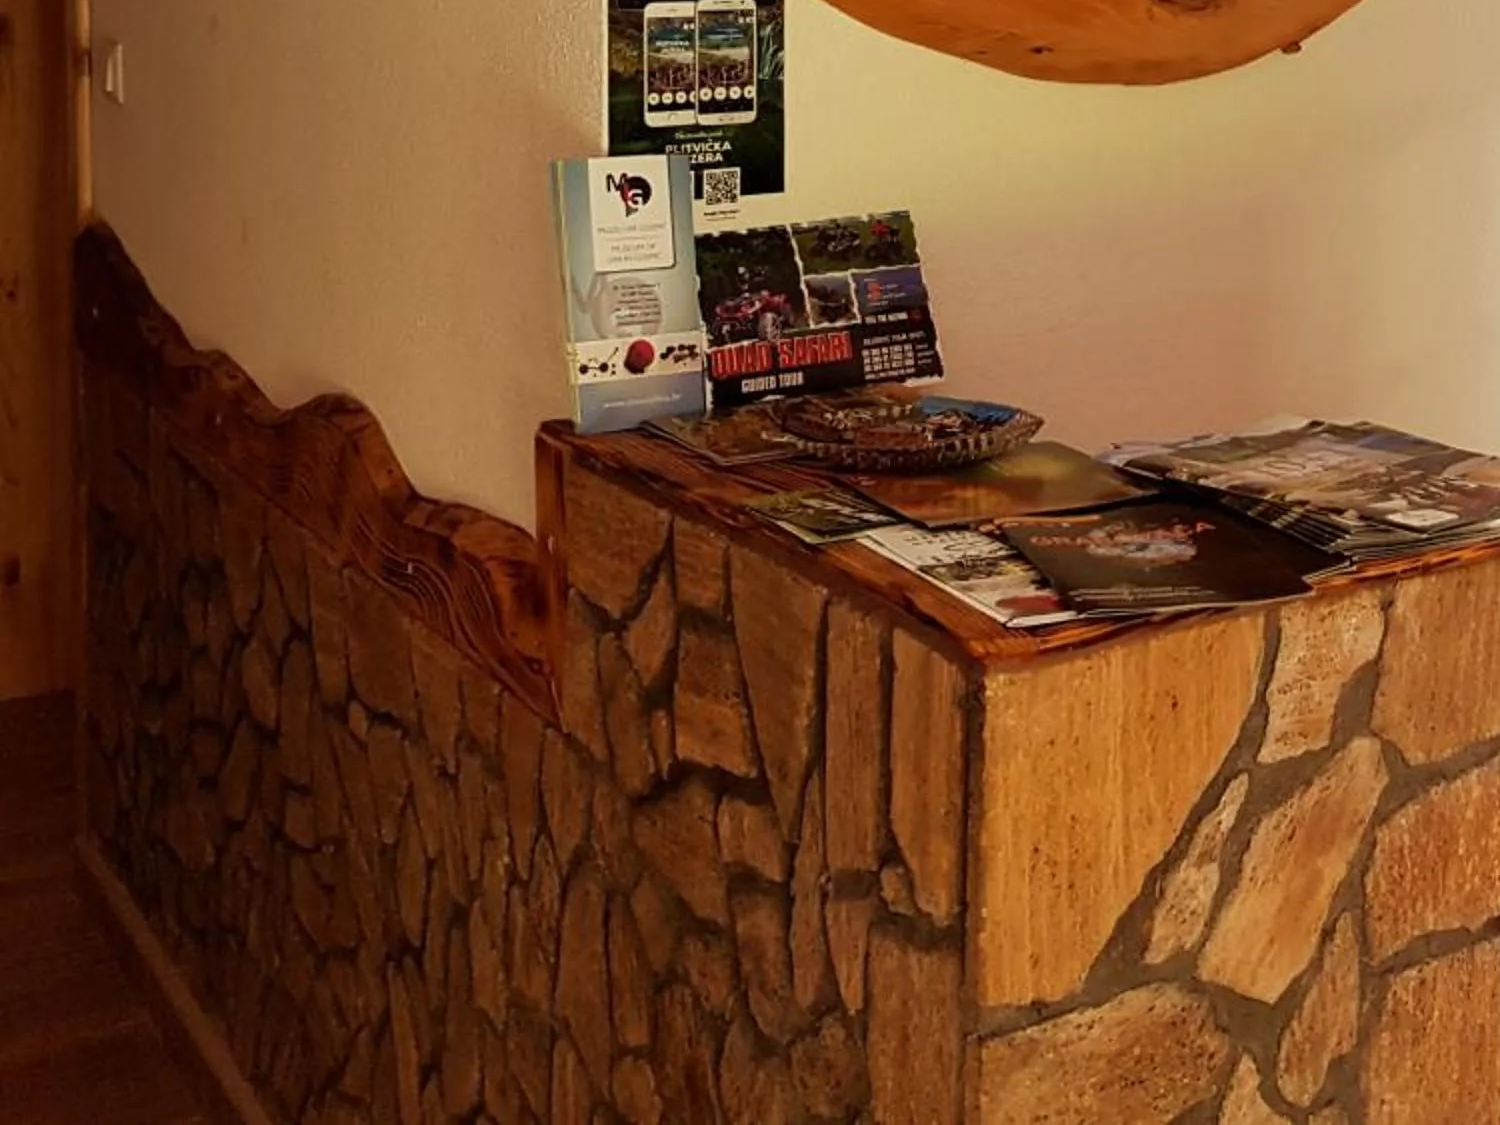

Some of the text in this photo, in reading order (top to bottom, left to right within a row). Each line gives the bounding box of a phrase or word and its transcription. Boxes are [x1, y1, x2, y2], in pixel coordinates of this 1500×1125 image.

[665, 138, 733, 154] PLITVIČKA
[690, 152, 724, 164] ZERA
[711, 340, 773, 381] QUAD
[778, 330, 853, 370] SAFARI
[741, 371, 805, 394] GUIDED TOUR
